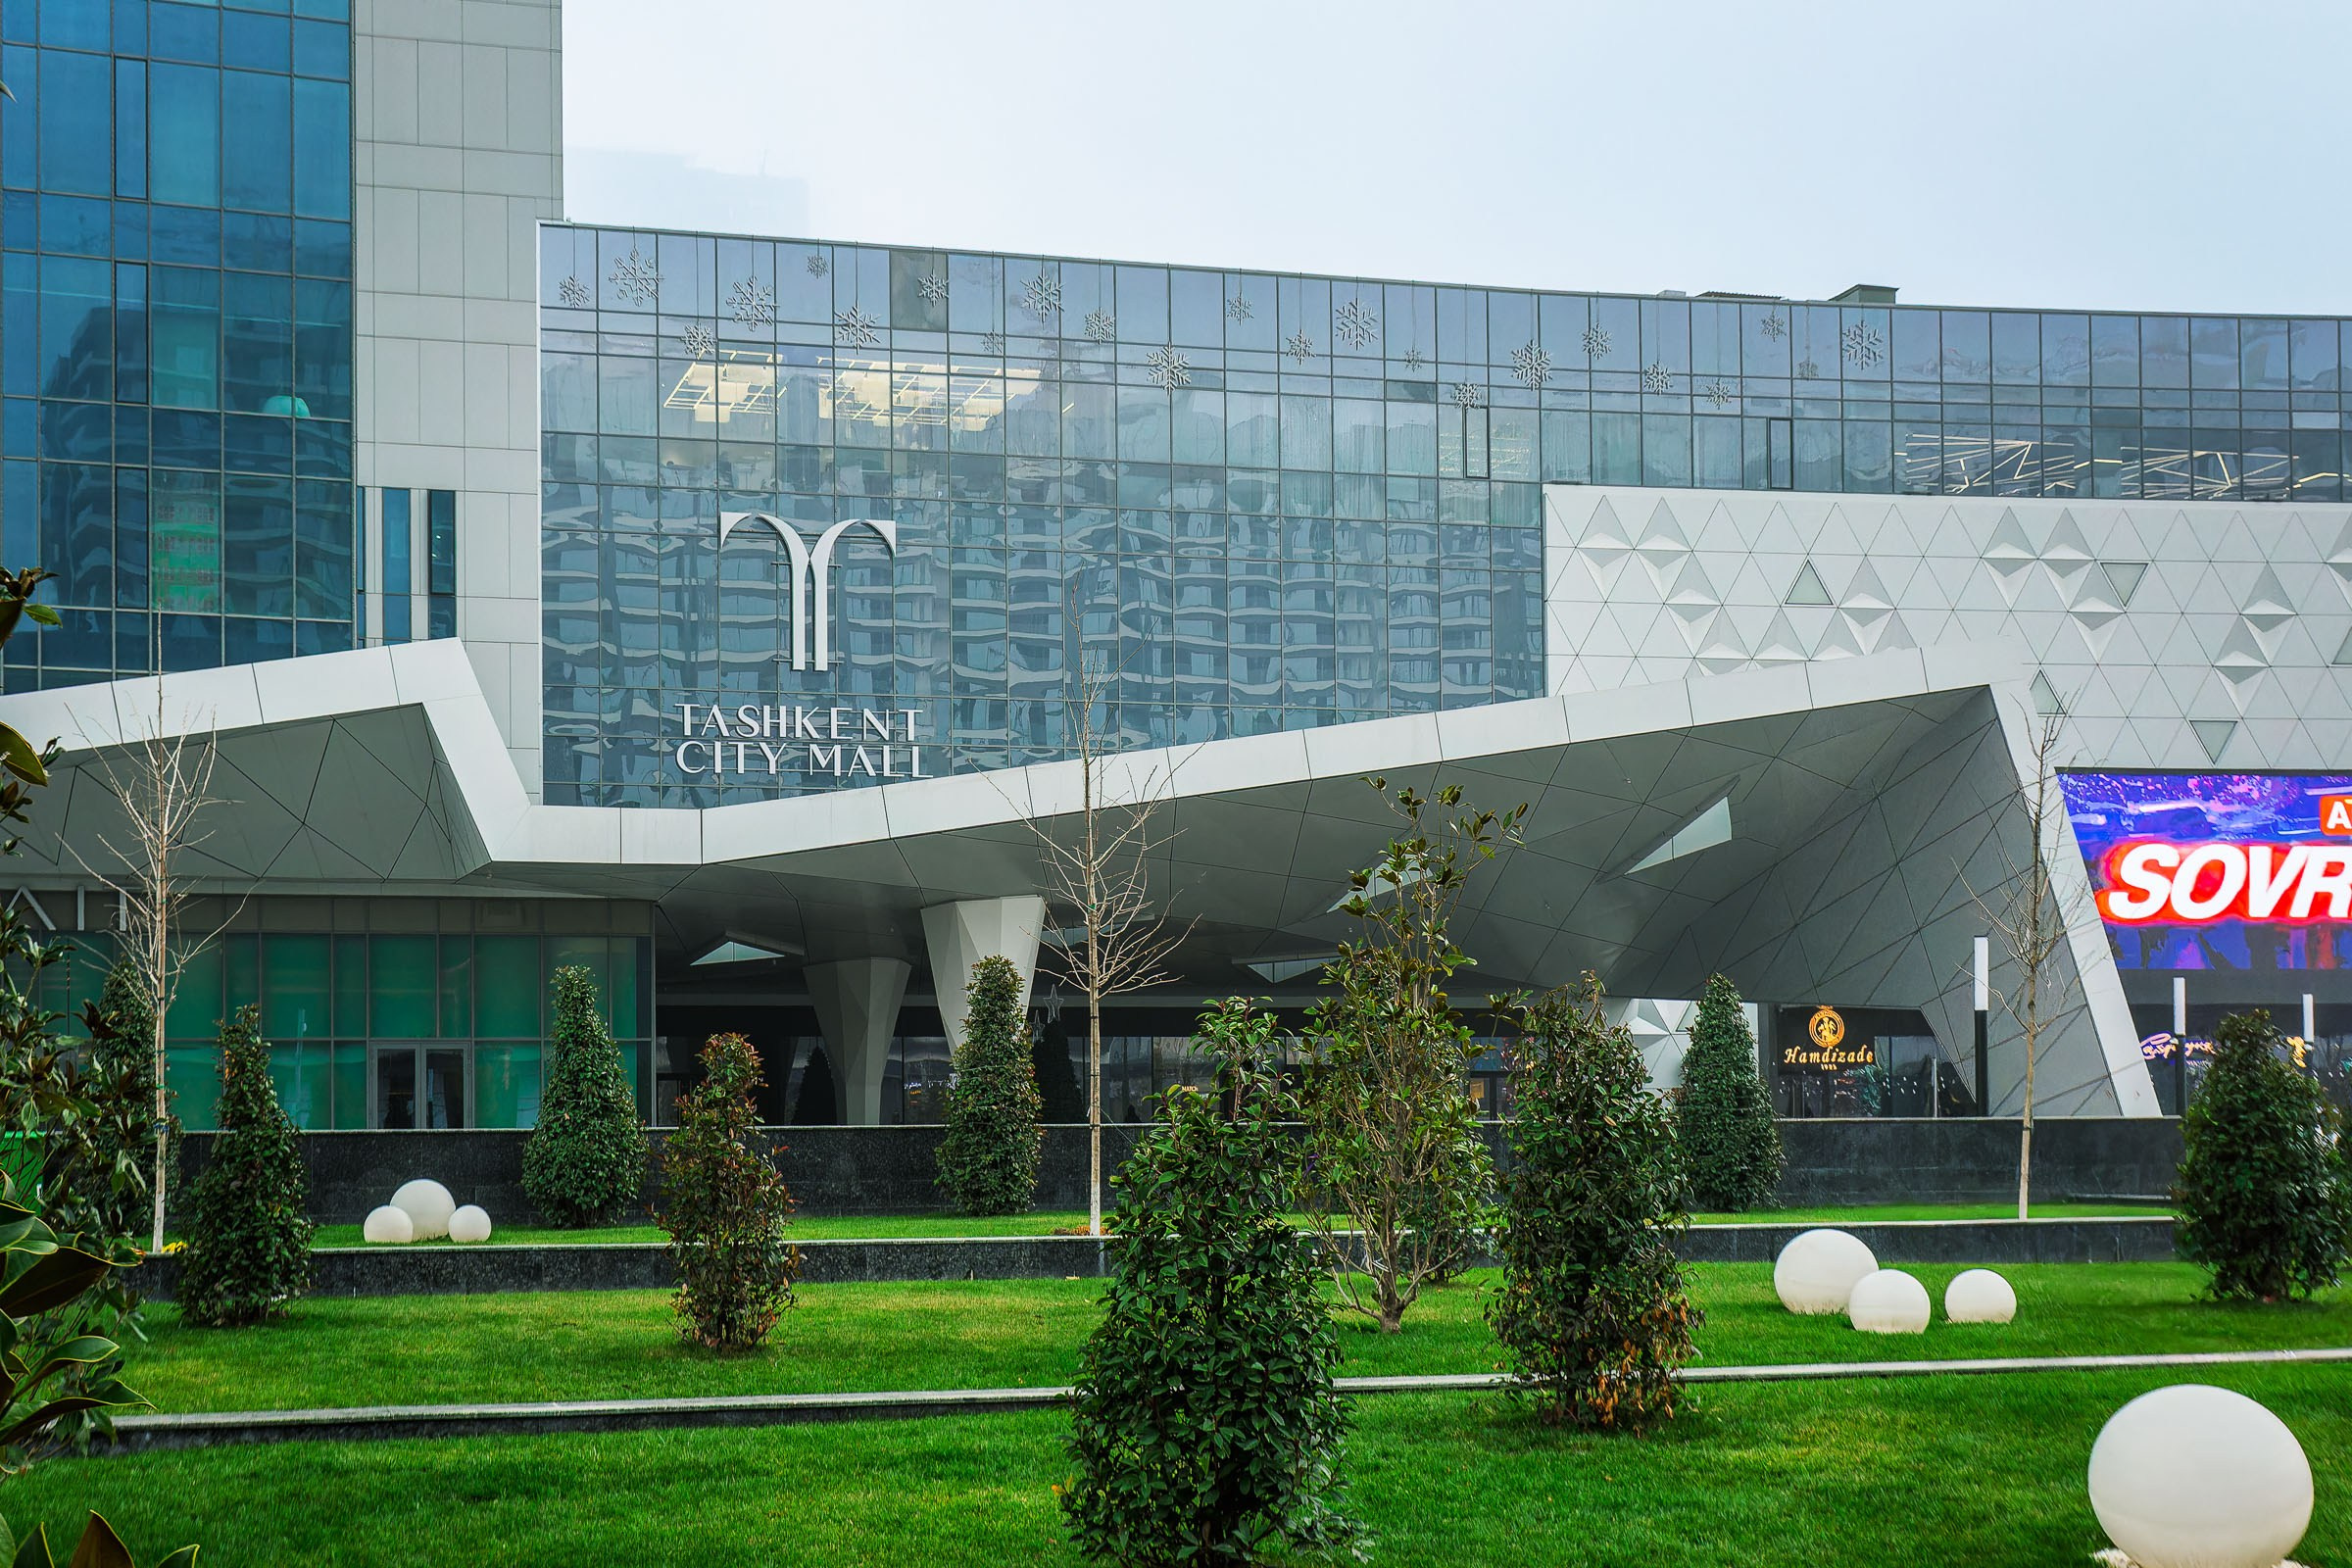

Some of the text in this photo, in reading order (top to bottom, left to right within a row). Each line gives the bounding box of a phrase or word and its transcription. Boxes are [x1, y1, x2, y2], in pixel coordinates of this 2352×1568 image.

[674, 703, 924, 742] TASHKENT
[676, 741, 933, 778] CITY MALL
[1784, 1045, 1874, 1063] Hamdizade
